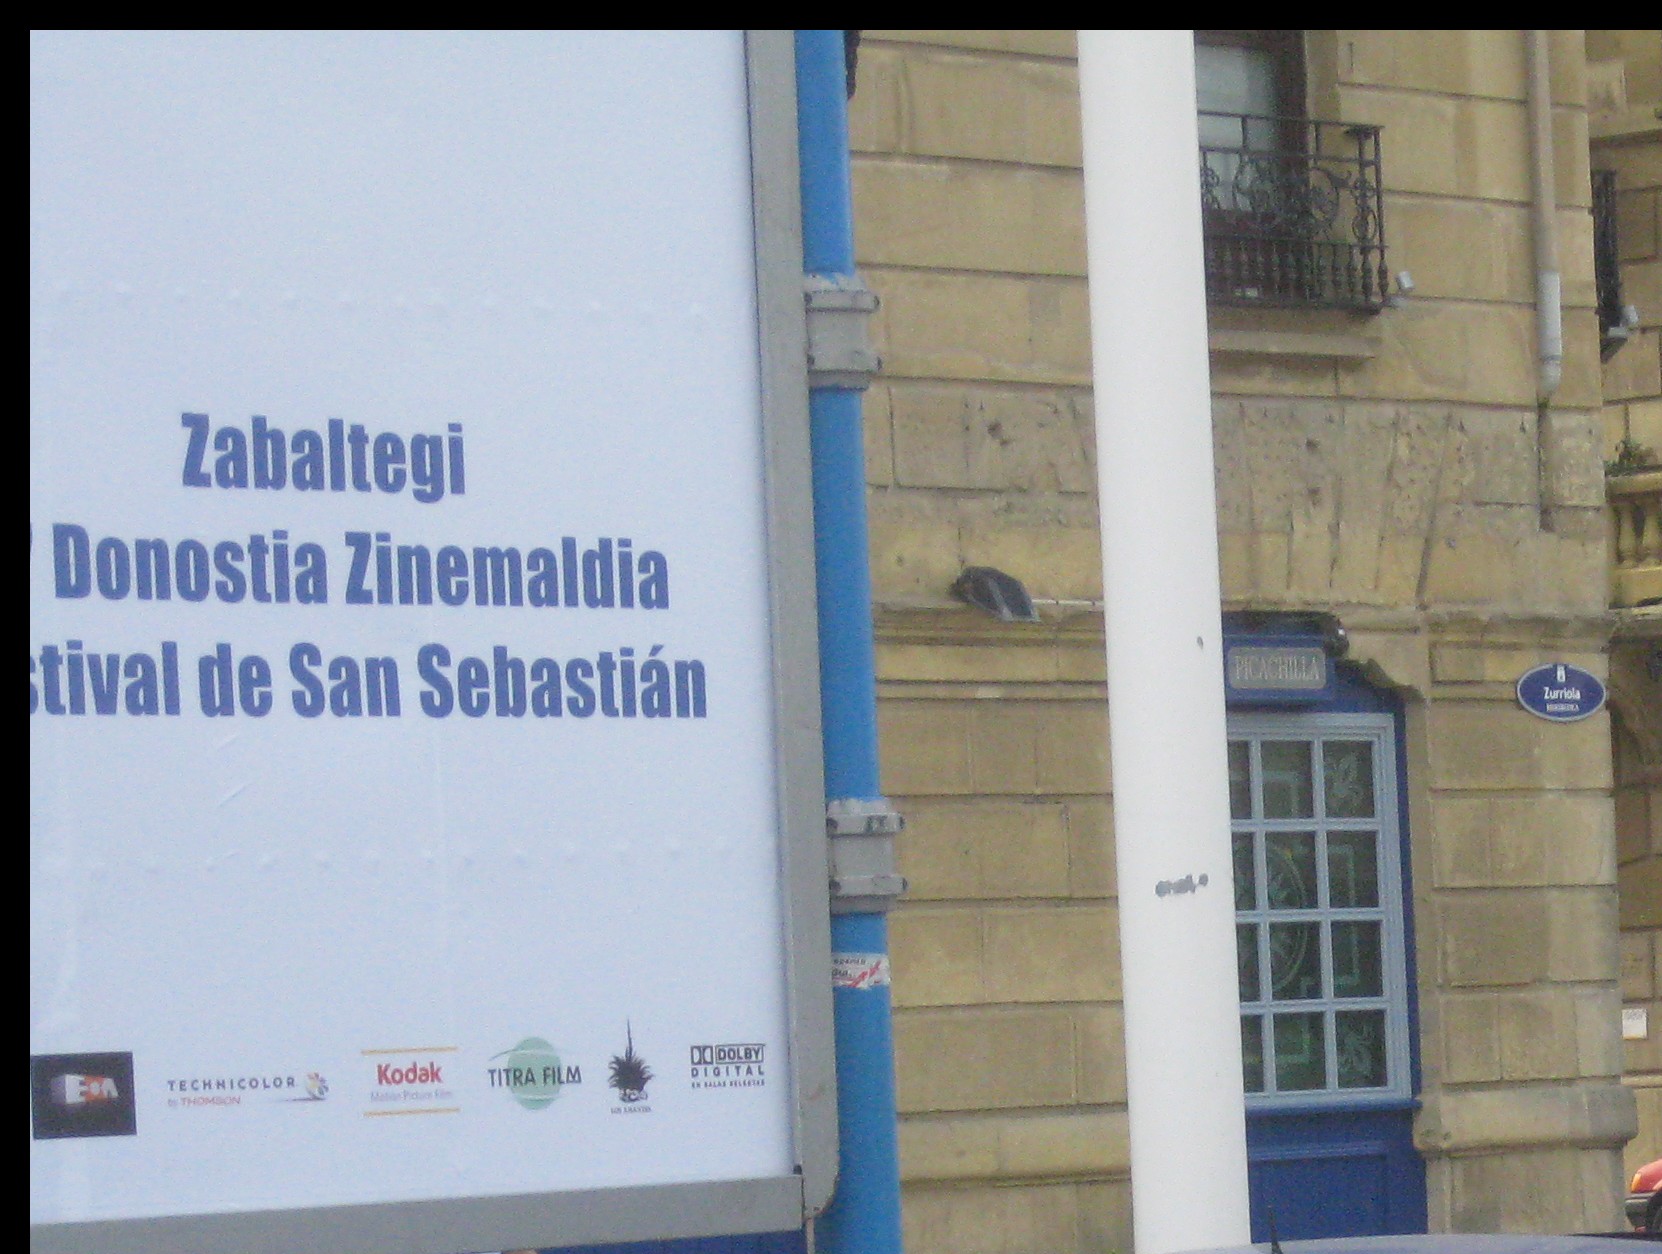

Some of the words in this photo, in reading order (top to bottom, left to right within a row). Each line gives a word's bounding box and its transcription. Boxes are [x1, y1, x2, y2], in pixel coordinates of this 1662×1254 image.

[180, 411, 465, 504] Zabaltegi
[52, 522, 328, 605] Donostia
[344, 531, 670, 610] Zinemaldia
[198, 642, 273, 718] de
[288, 641, 401, 719] San
[416, 642, 707, 719] Sebastián
[1543, 686, 1581, 700] Zurriola
[717, 1047, 761, 1061] DOLBY
[376, 1060, 444, 1086] Kodak
[487, 1065, 537, 1088] TITRA
[542, 1064, 583, 1086] FILM
[690, 1064, 765, 1079] DIGITAL
[167, 1076, 297, 1092] TECHNICOLOR
[181, 1095, 242, 1107] THOMSON
